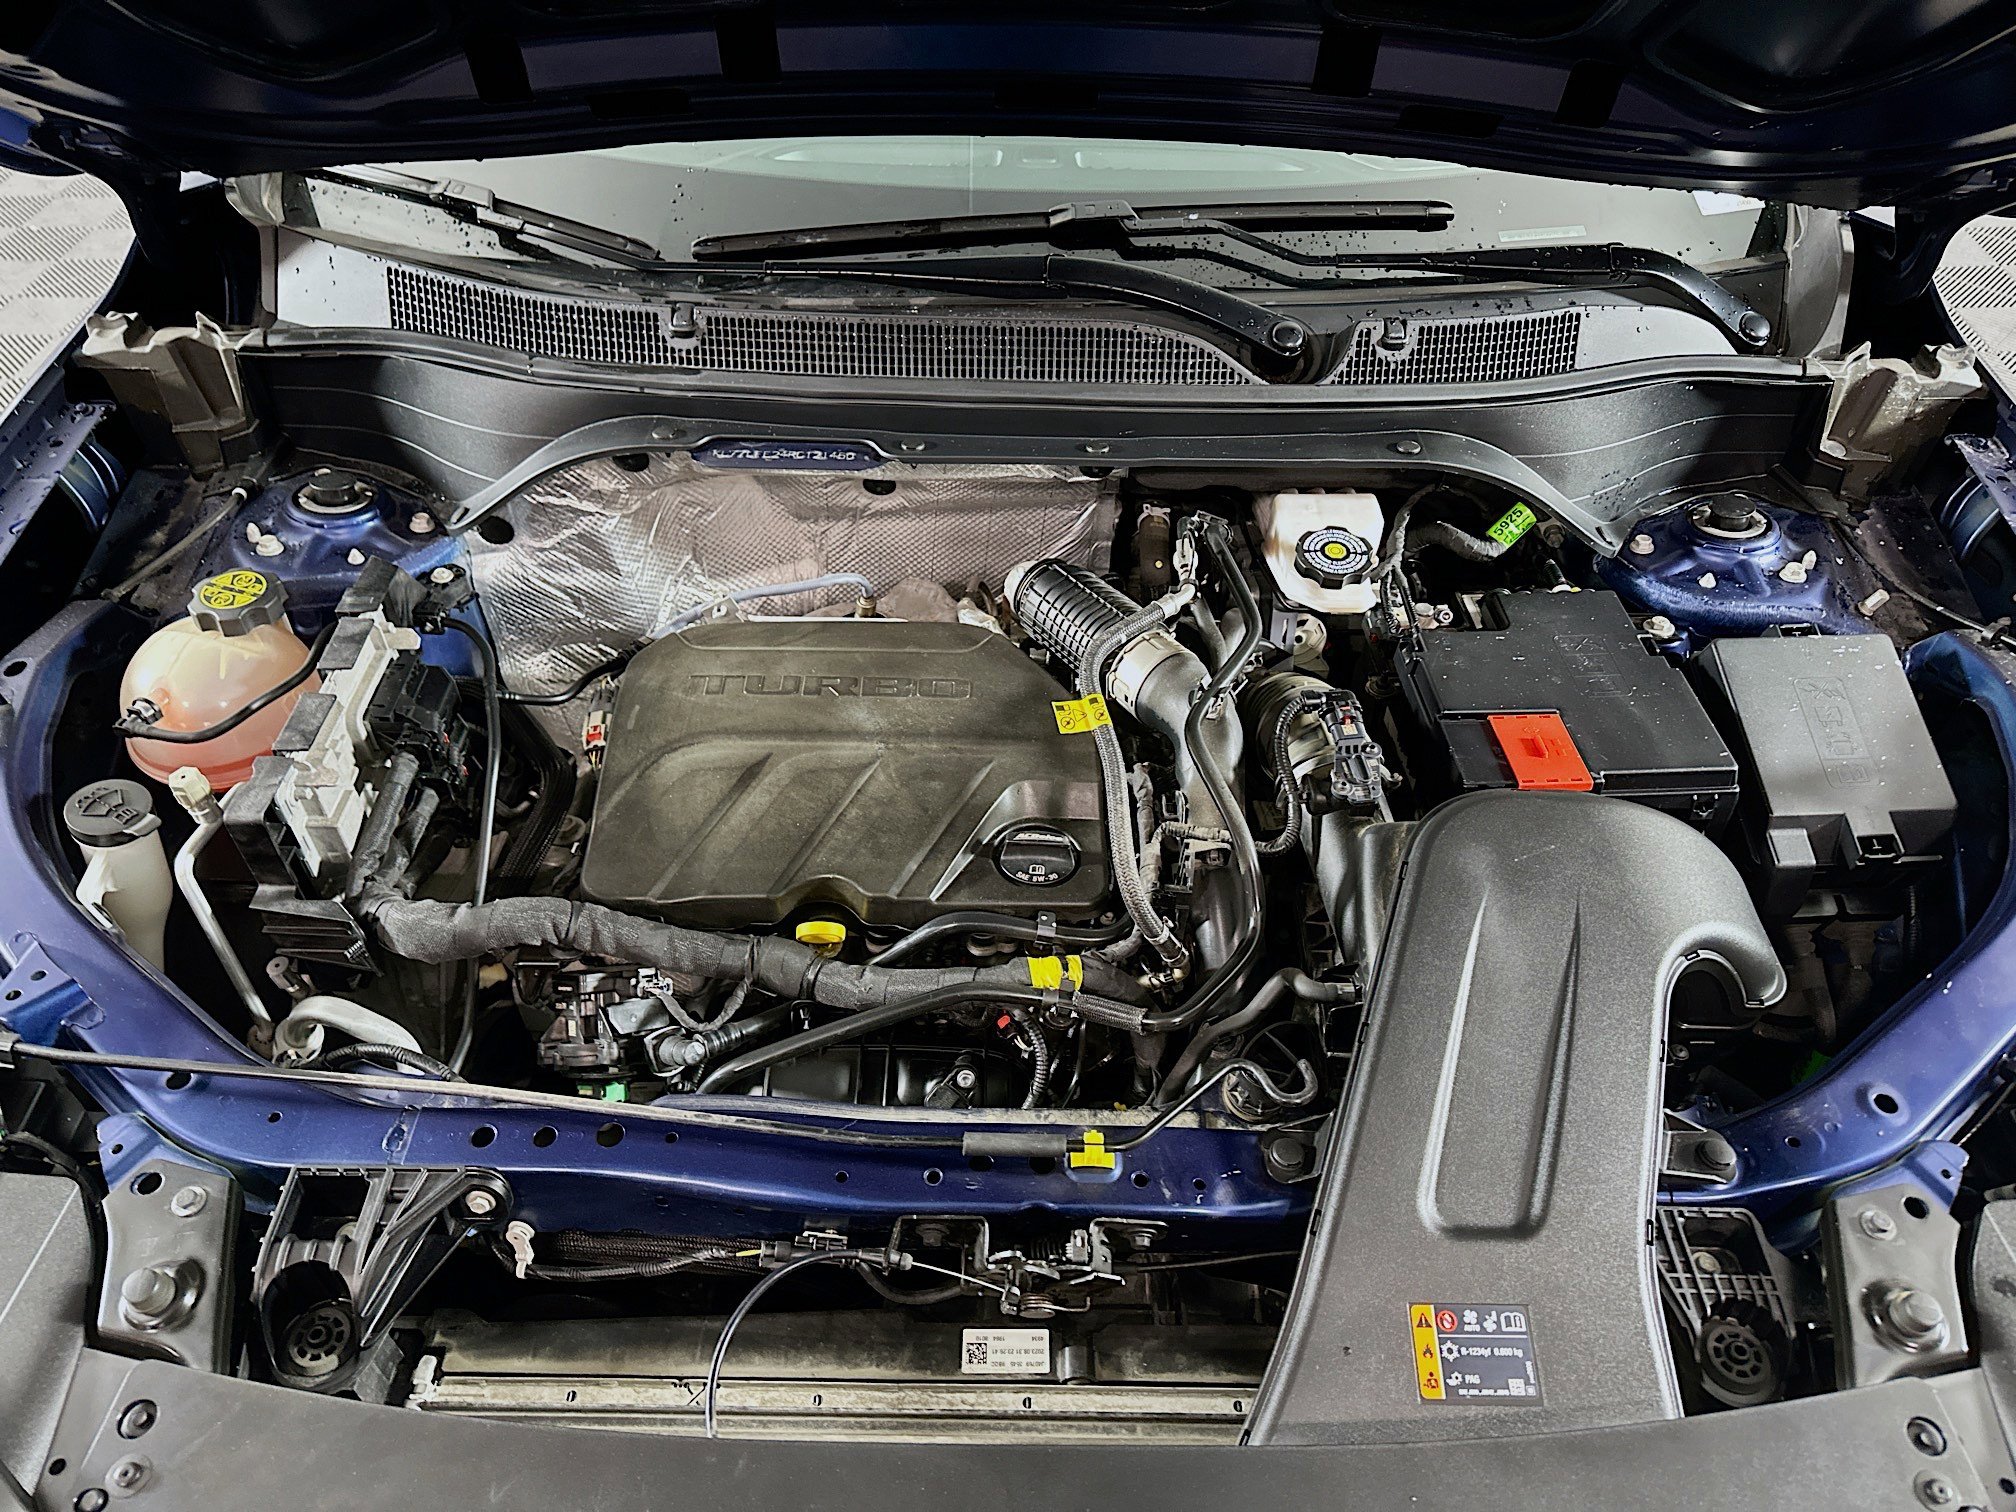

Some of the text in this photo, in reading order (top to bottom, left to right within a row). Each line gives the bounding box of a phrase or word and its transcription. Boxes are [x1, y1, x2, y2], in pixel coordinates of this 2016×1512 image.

[1493, 508, 1523, 536] 5925
[689, 674, 972, 698] TURBO
[1015, 871, 1059, 882] SAE 5W-30
[1464, 1374, 1480, 1384] PAG
